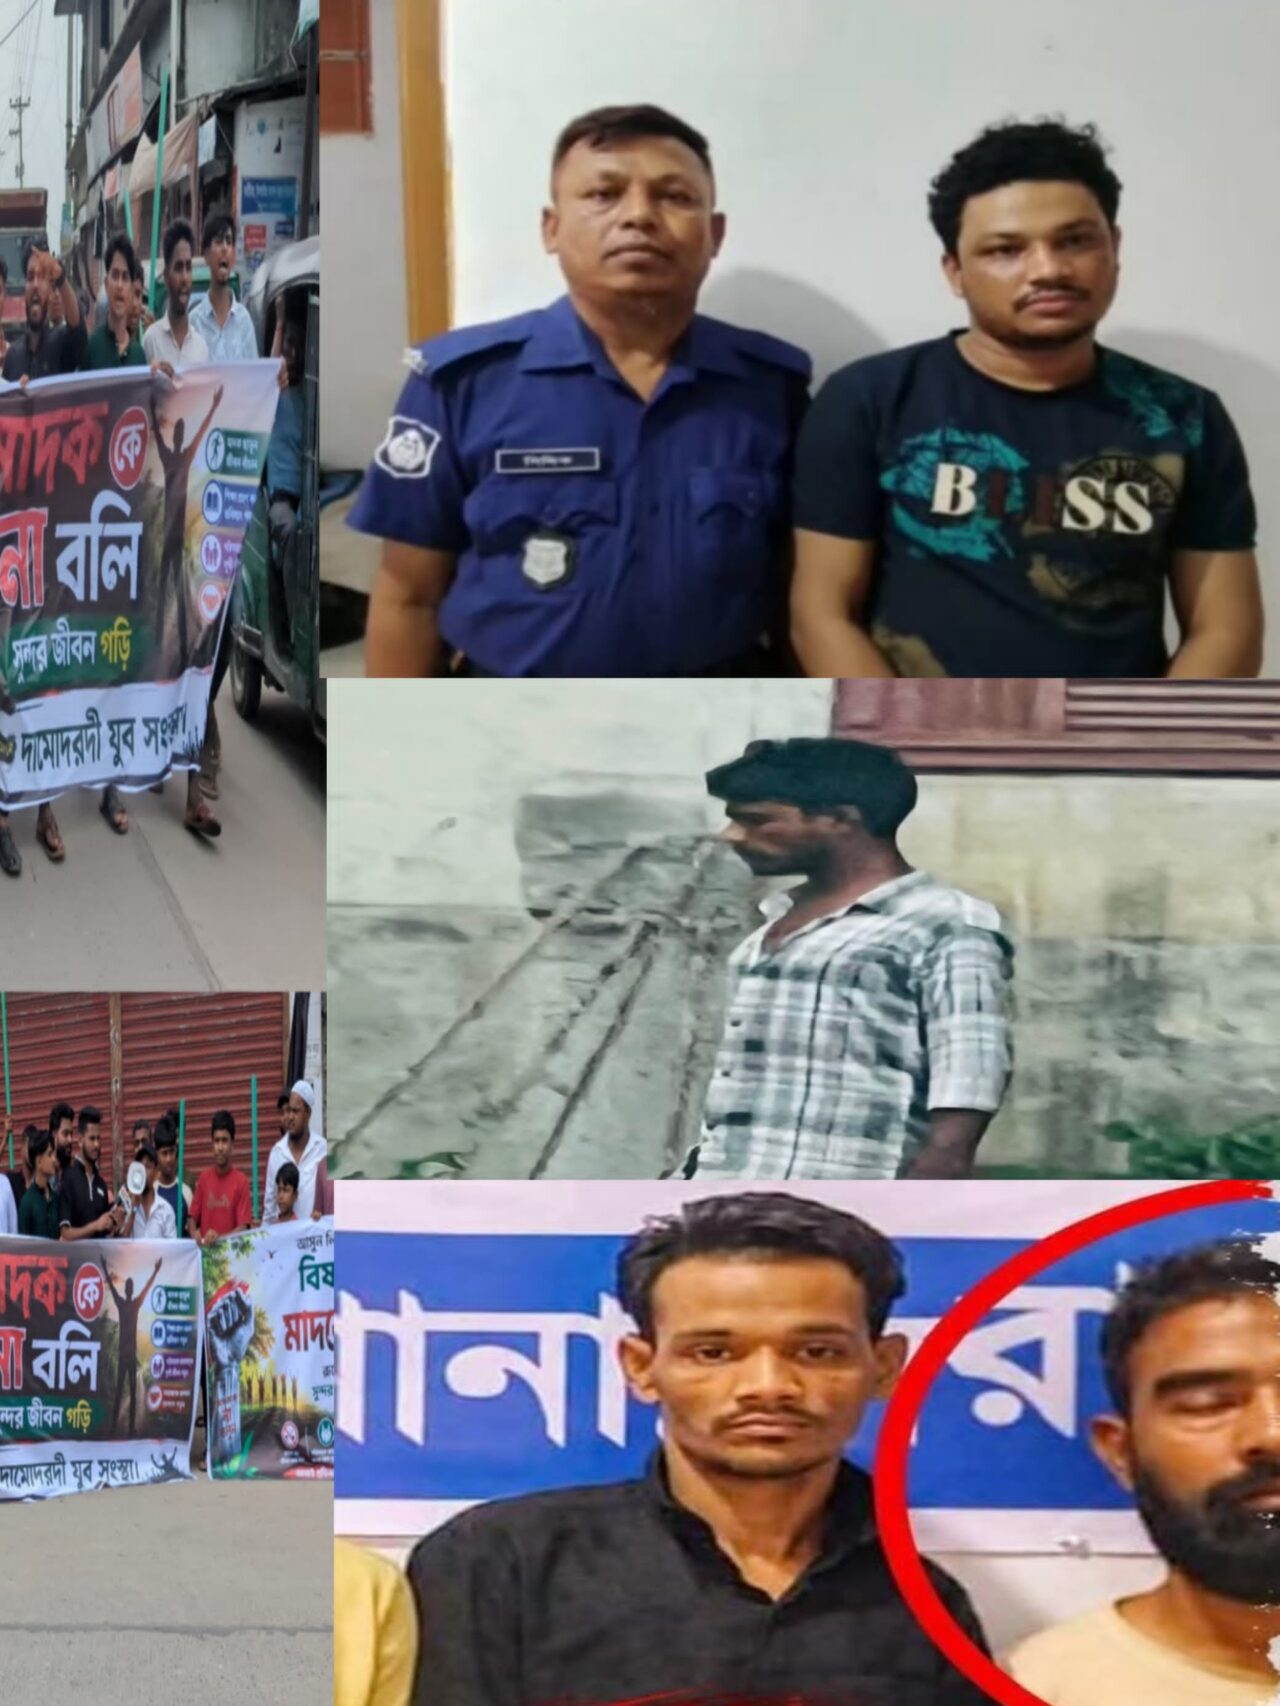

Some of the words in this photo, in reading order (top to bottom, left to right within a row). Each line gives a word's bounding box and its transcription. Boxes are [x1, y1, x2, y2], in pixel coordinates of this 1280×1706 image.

[114, 421, 146, 468] কে
[55, 489, 143, 602] বলি
[12, 637, 48, 684] সুন্দর
[50, 616, 97, 667] জীবন
[100, 616, 132, 672] গড়ি
[21, 707, 101, 773] দামোদরদী
[108, 718, 136, 768] যুব
[76, 1277, 100, 1310] কে
[32, 1320, 101, 1391] বলি
[26, 1397, 63, 1429] জীবন
[66, 1399, 92, 1433] গড়ি
[0, 1452, 66, 1490] দামোদরদী
[71, 1460, 93, 1491] যুব
